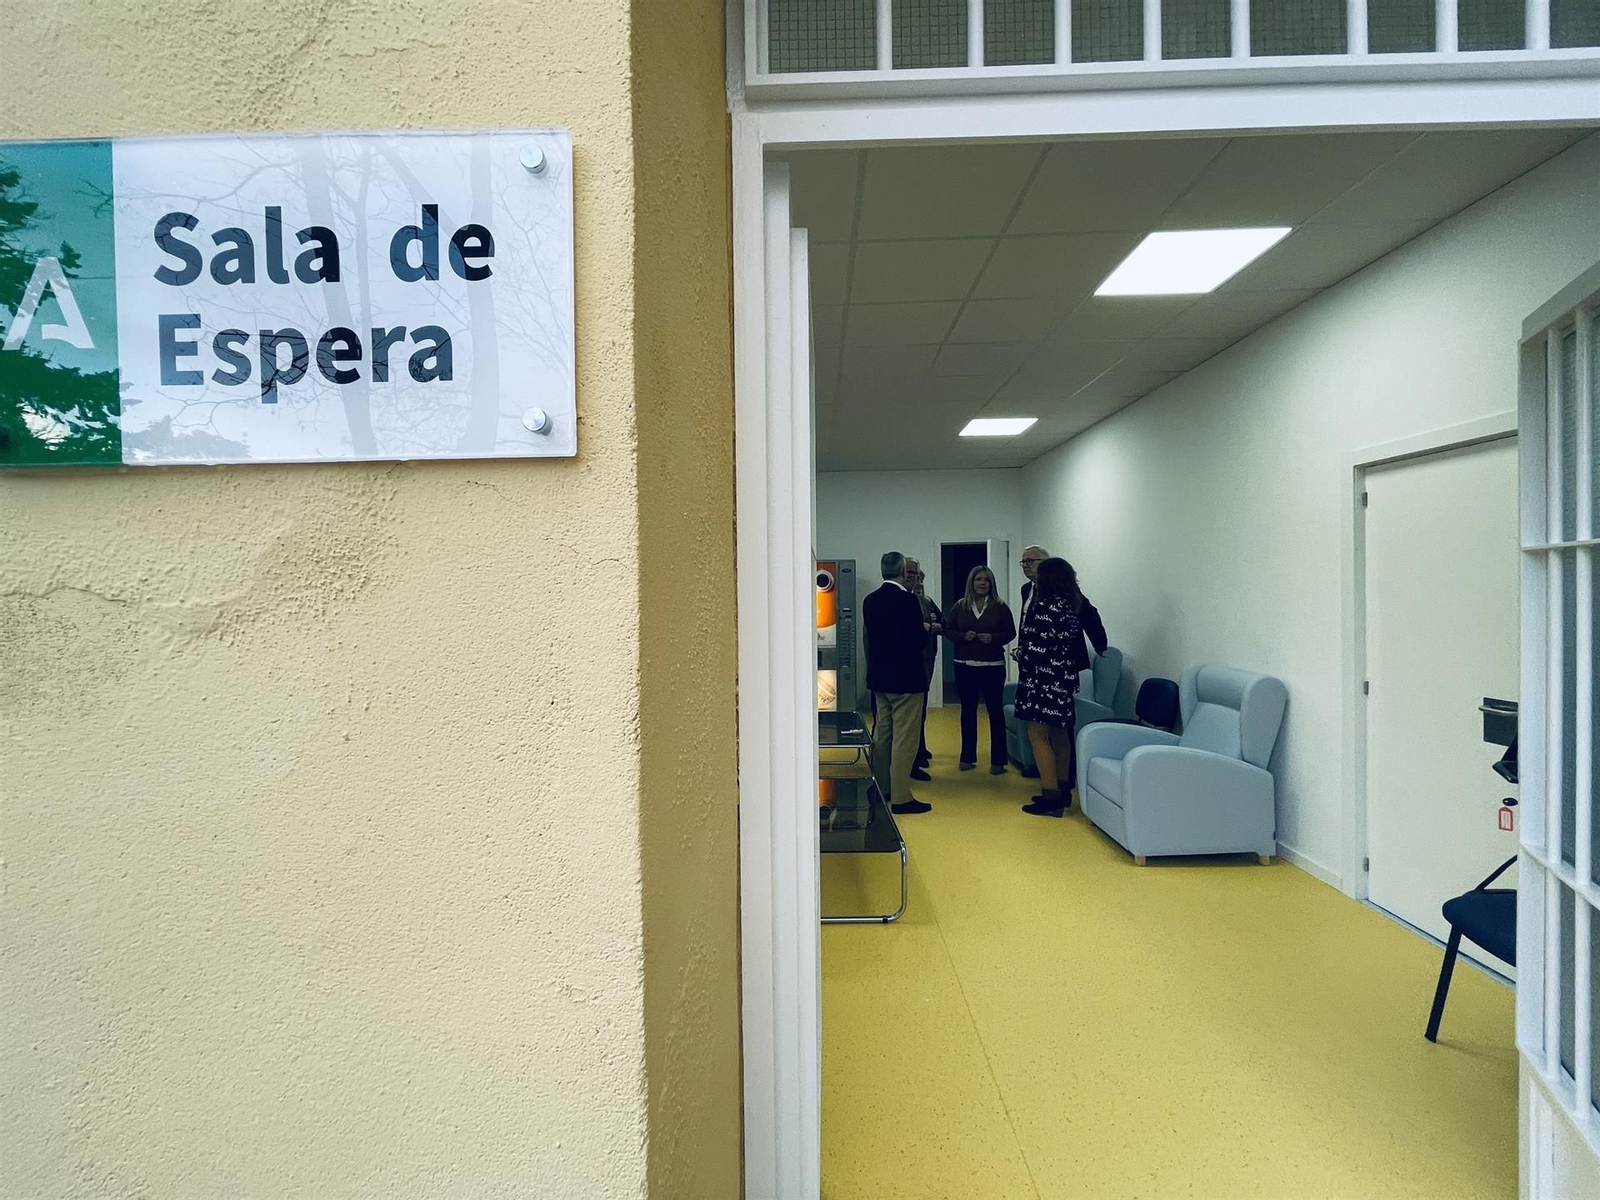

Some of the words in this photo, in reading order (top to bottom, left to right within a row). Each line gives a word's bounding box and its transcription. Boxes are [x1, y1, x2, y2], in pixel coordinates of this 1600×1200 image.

[153, 205, 341, 287] Sala
[389, 204, 496, 282] de
[158, 313, 454, 404] Espera
